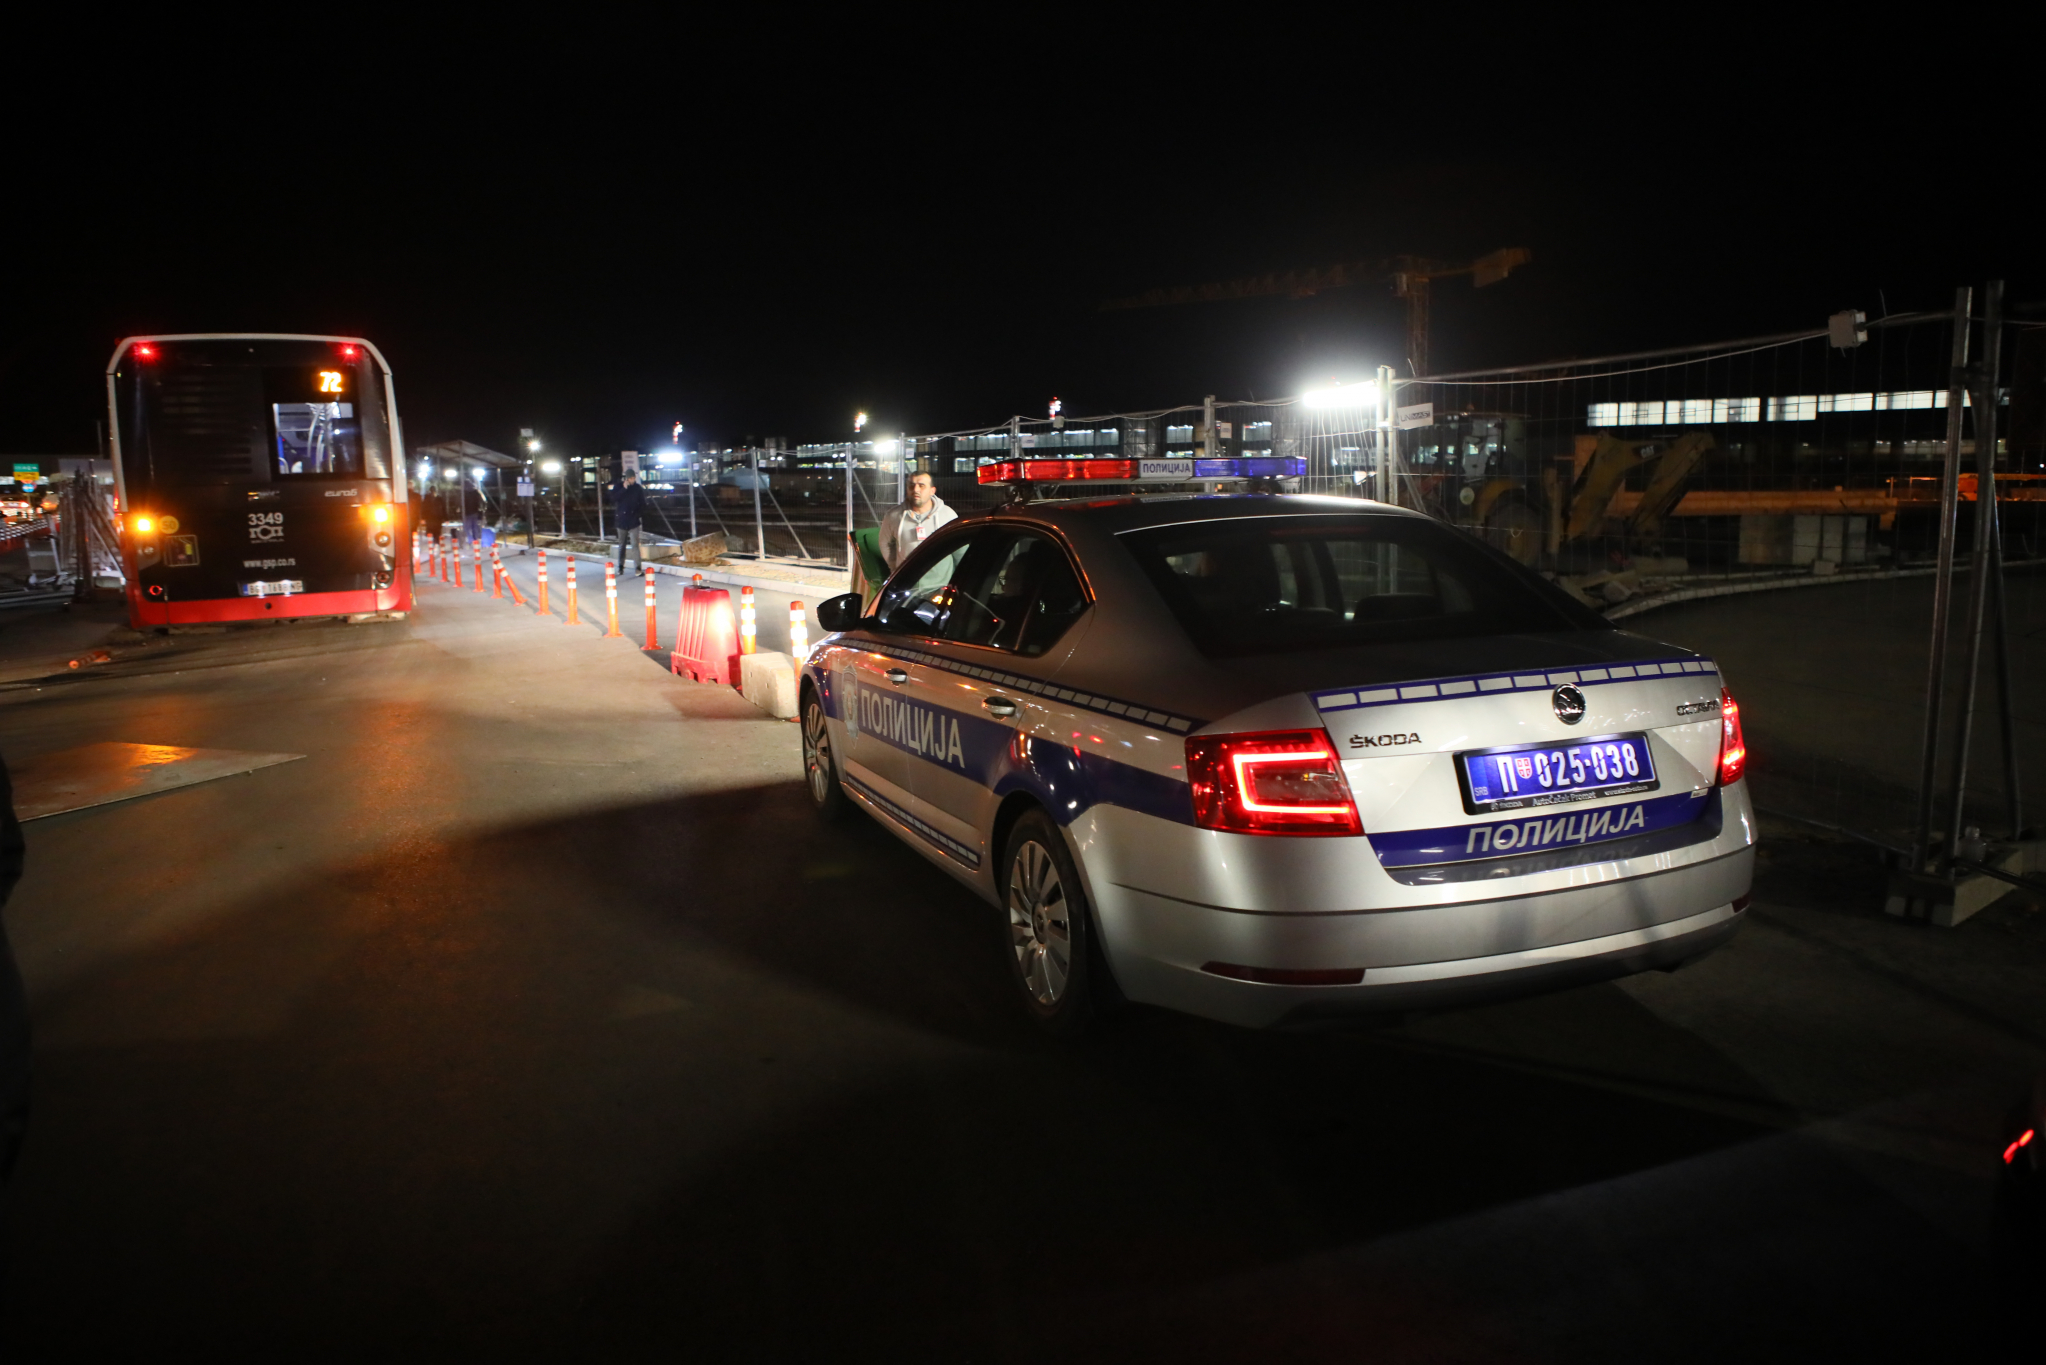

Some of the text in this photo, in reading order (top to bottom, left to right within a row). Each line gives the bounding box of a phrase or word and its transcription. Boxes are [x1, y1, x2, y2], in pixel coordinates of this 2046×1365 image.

[320, 371, 342, 392] 72
[1143, 463, 1191, 474] ПОЛИЦИЈА
[162, 520, 177, 531] 50
[248, 512, 284, 526] 3349
[243, 558, 297, 570] www.gsp.co.rs
[861, 689, 966, 769] ПОЛИЦИЈА
[1349, 733, 1422, 749] ŠKODA
[1474, 786, 1489, 797] SRB
[1466, 805, 1645, 854] ПОЛИЦИЈА
